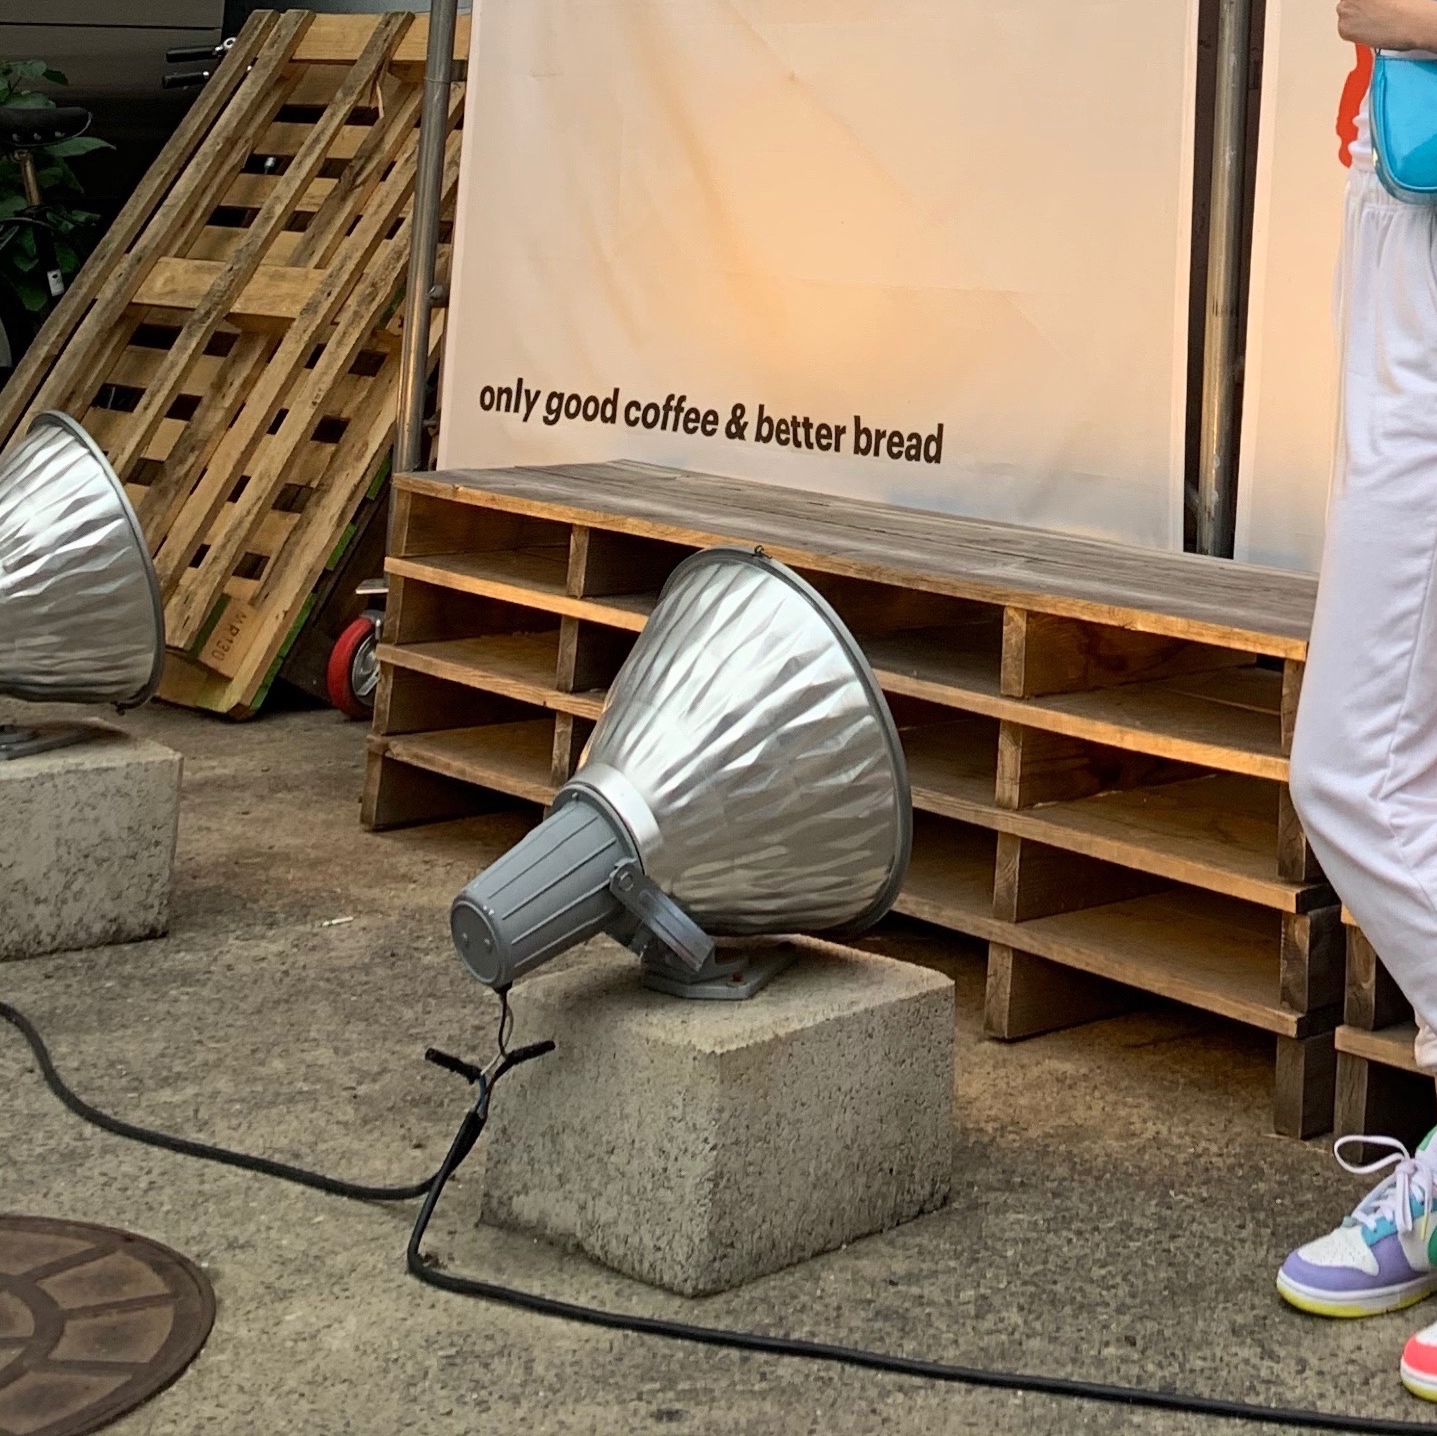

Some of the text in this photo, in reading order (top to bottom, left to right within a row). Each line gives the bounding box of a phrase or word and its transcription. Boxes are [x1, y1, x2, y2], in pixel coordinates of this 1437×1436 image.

[479, 377, 944, 464] only good coffee & better bread
